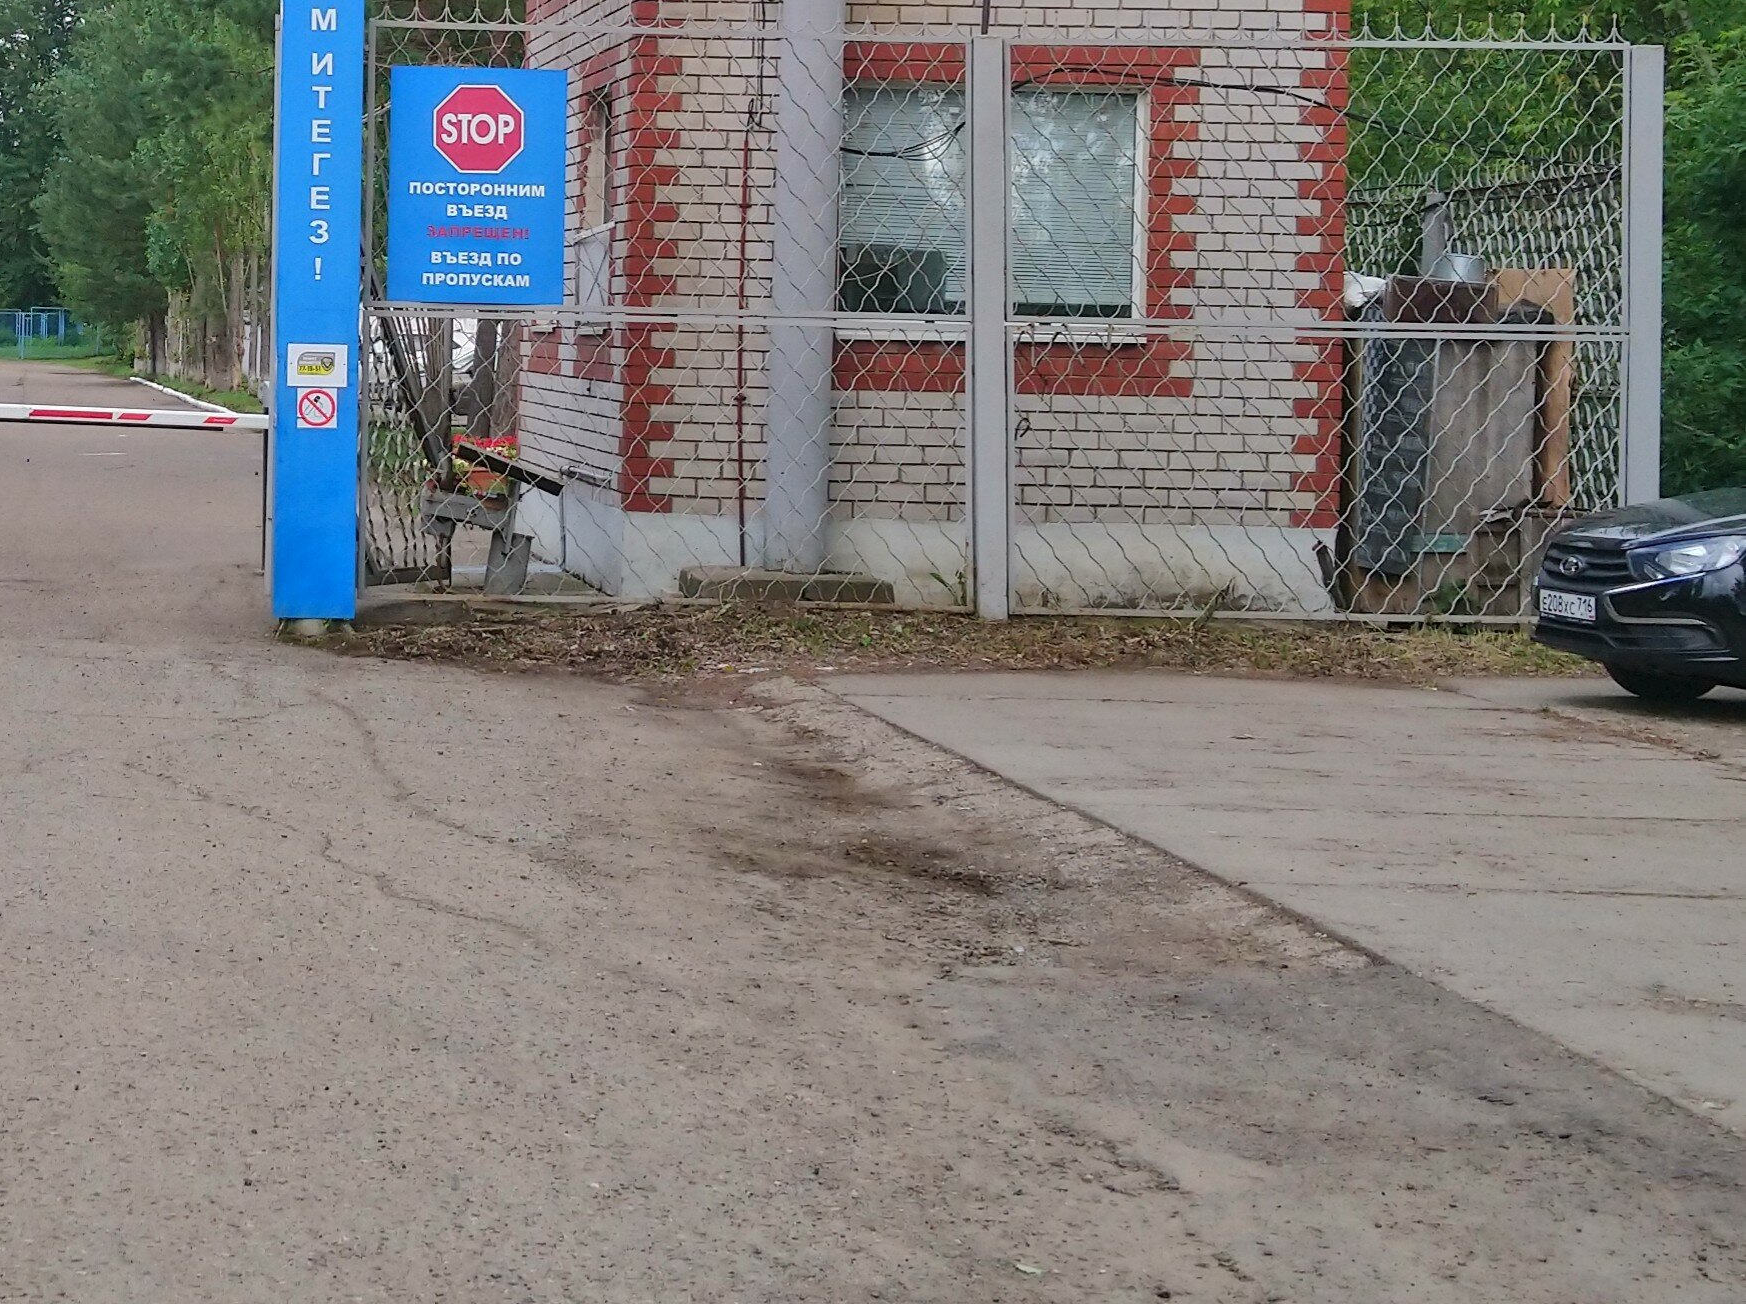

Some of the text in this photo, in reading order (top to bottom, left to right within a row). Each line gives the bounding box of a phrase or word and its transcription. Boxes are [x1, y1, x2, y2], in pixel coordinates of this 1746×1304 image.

[440, 113, 515, 145] STOP
[409, 181, 545, 197] ПОСТОРОННИМ
[446, 204, 508, 220] ВЪЕЗД
[426, 225, 530, 240] ЗАПРЕЩЕН!
[431, 251, 522, 267] ВЪЕЗД ПО
[422, 272, 530, 287] ПРОПУСКАМ
